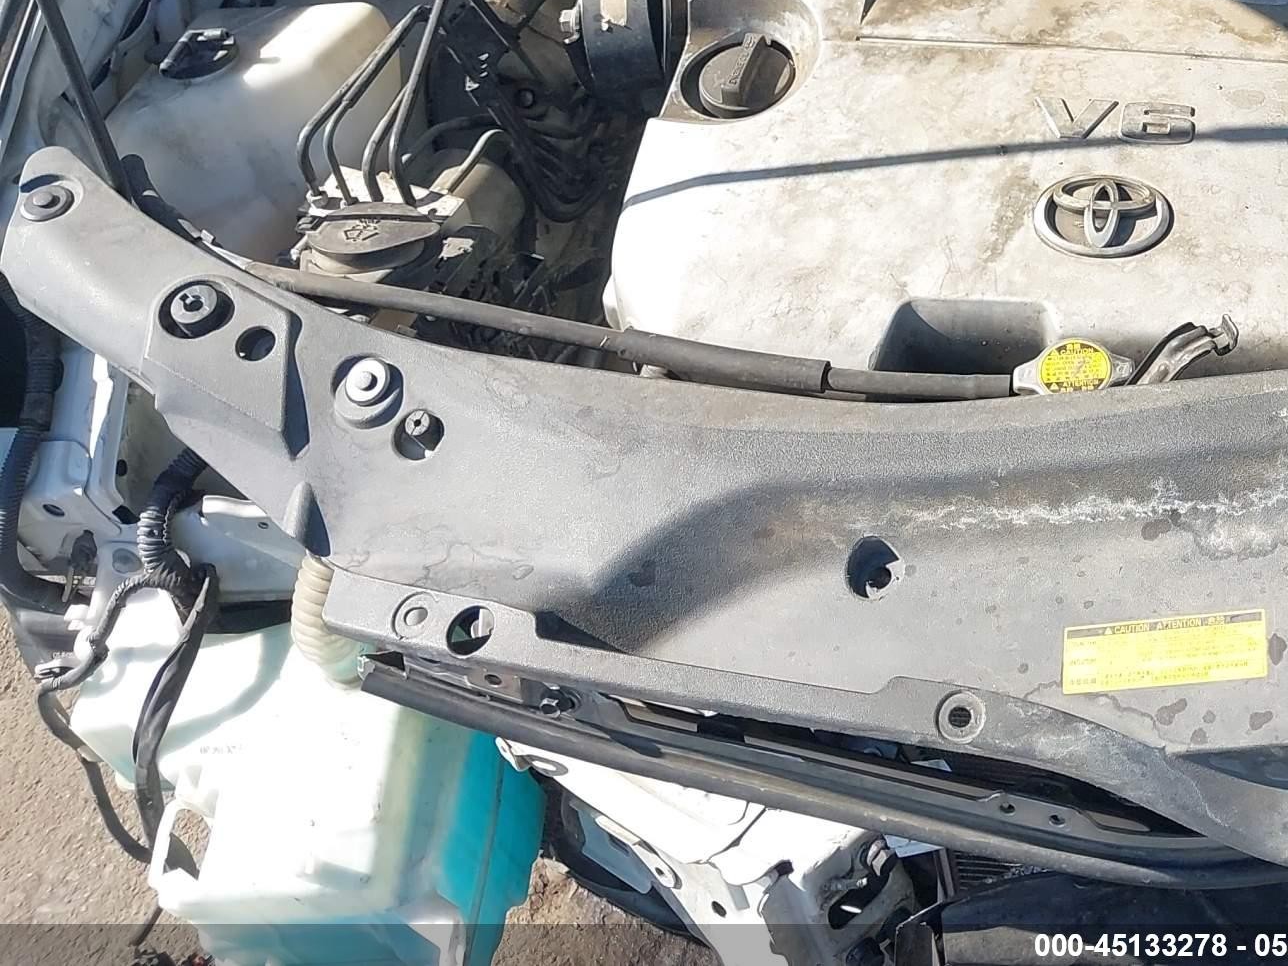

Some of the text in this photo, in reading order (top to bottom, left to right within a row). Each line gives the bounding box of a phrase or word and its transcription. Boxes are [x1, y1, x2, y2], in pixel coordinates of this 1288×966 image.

[1033, 96, 1196, 146] V6
[1060, 347, 1094, 356] CAUTION
[1062, 378, 1099, 388] ATTENTION
[1114, 623, 1150, 634] CAUTION
